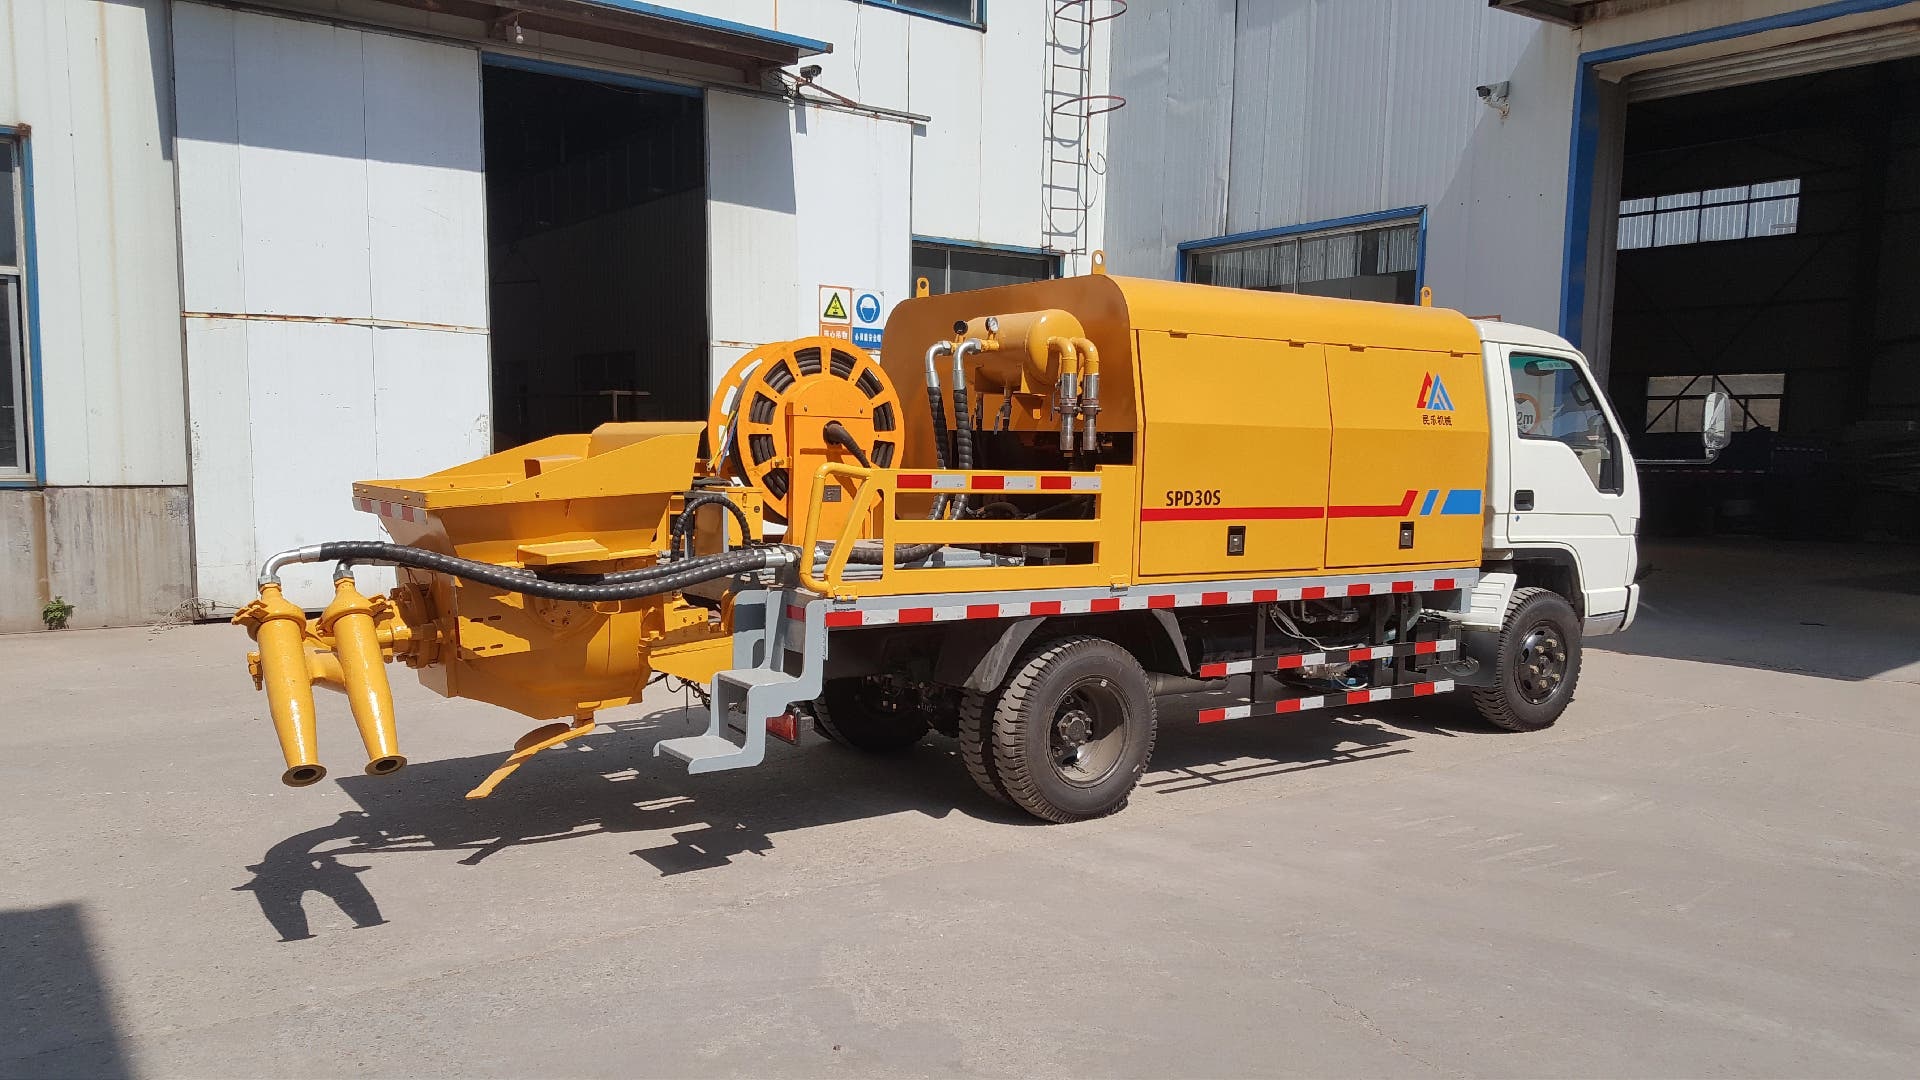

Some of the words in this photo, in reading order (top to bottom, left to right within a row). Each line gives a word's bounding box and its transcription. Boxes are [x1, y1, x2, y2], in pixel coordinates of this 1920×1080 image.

[1422, 414, 1453, 426] 民乐机械
[1165, 489, 1221, 507] SPD30S
